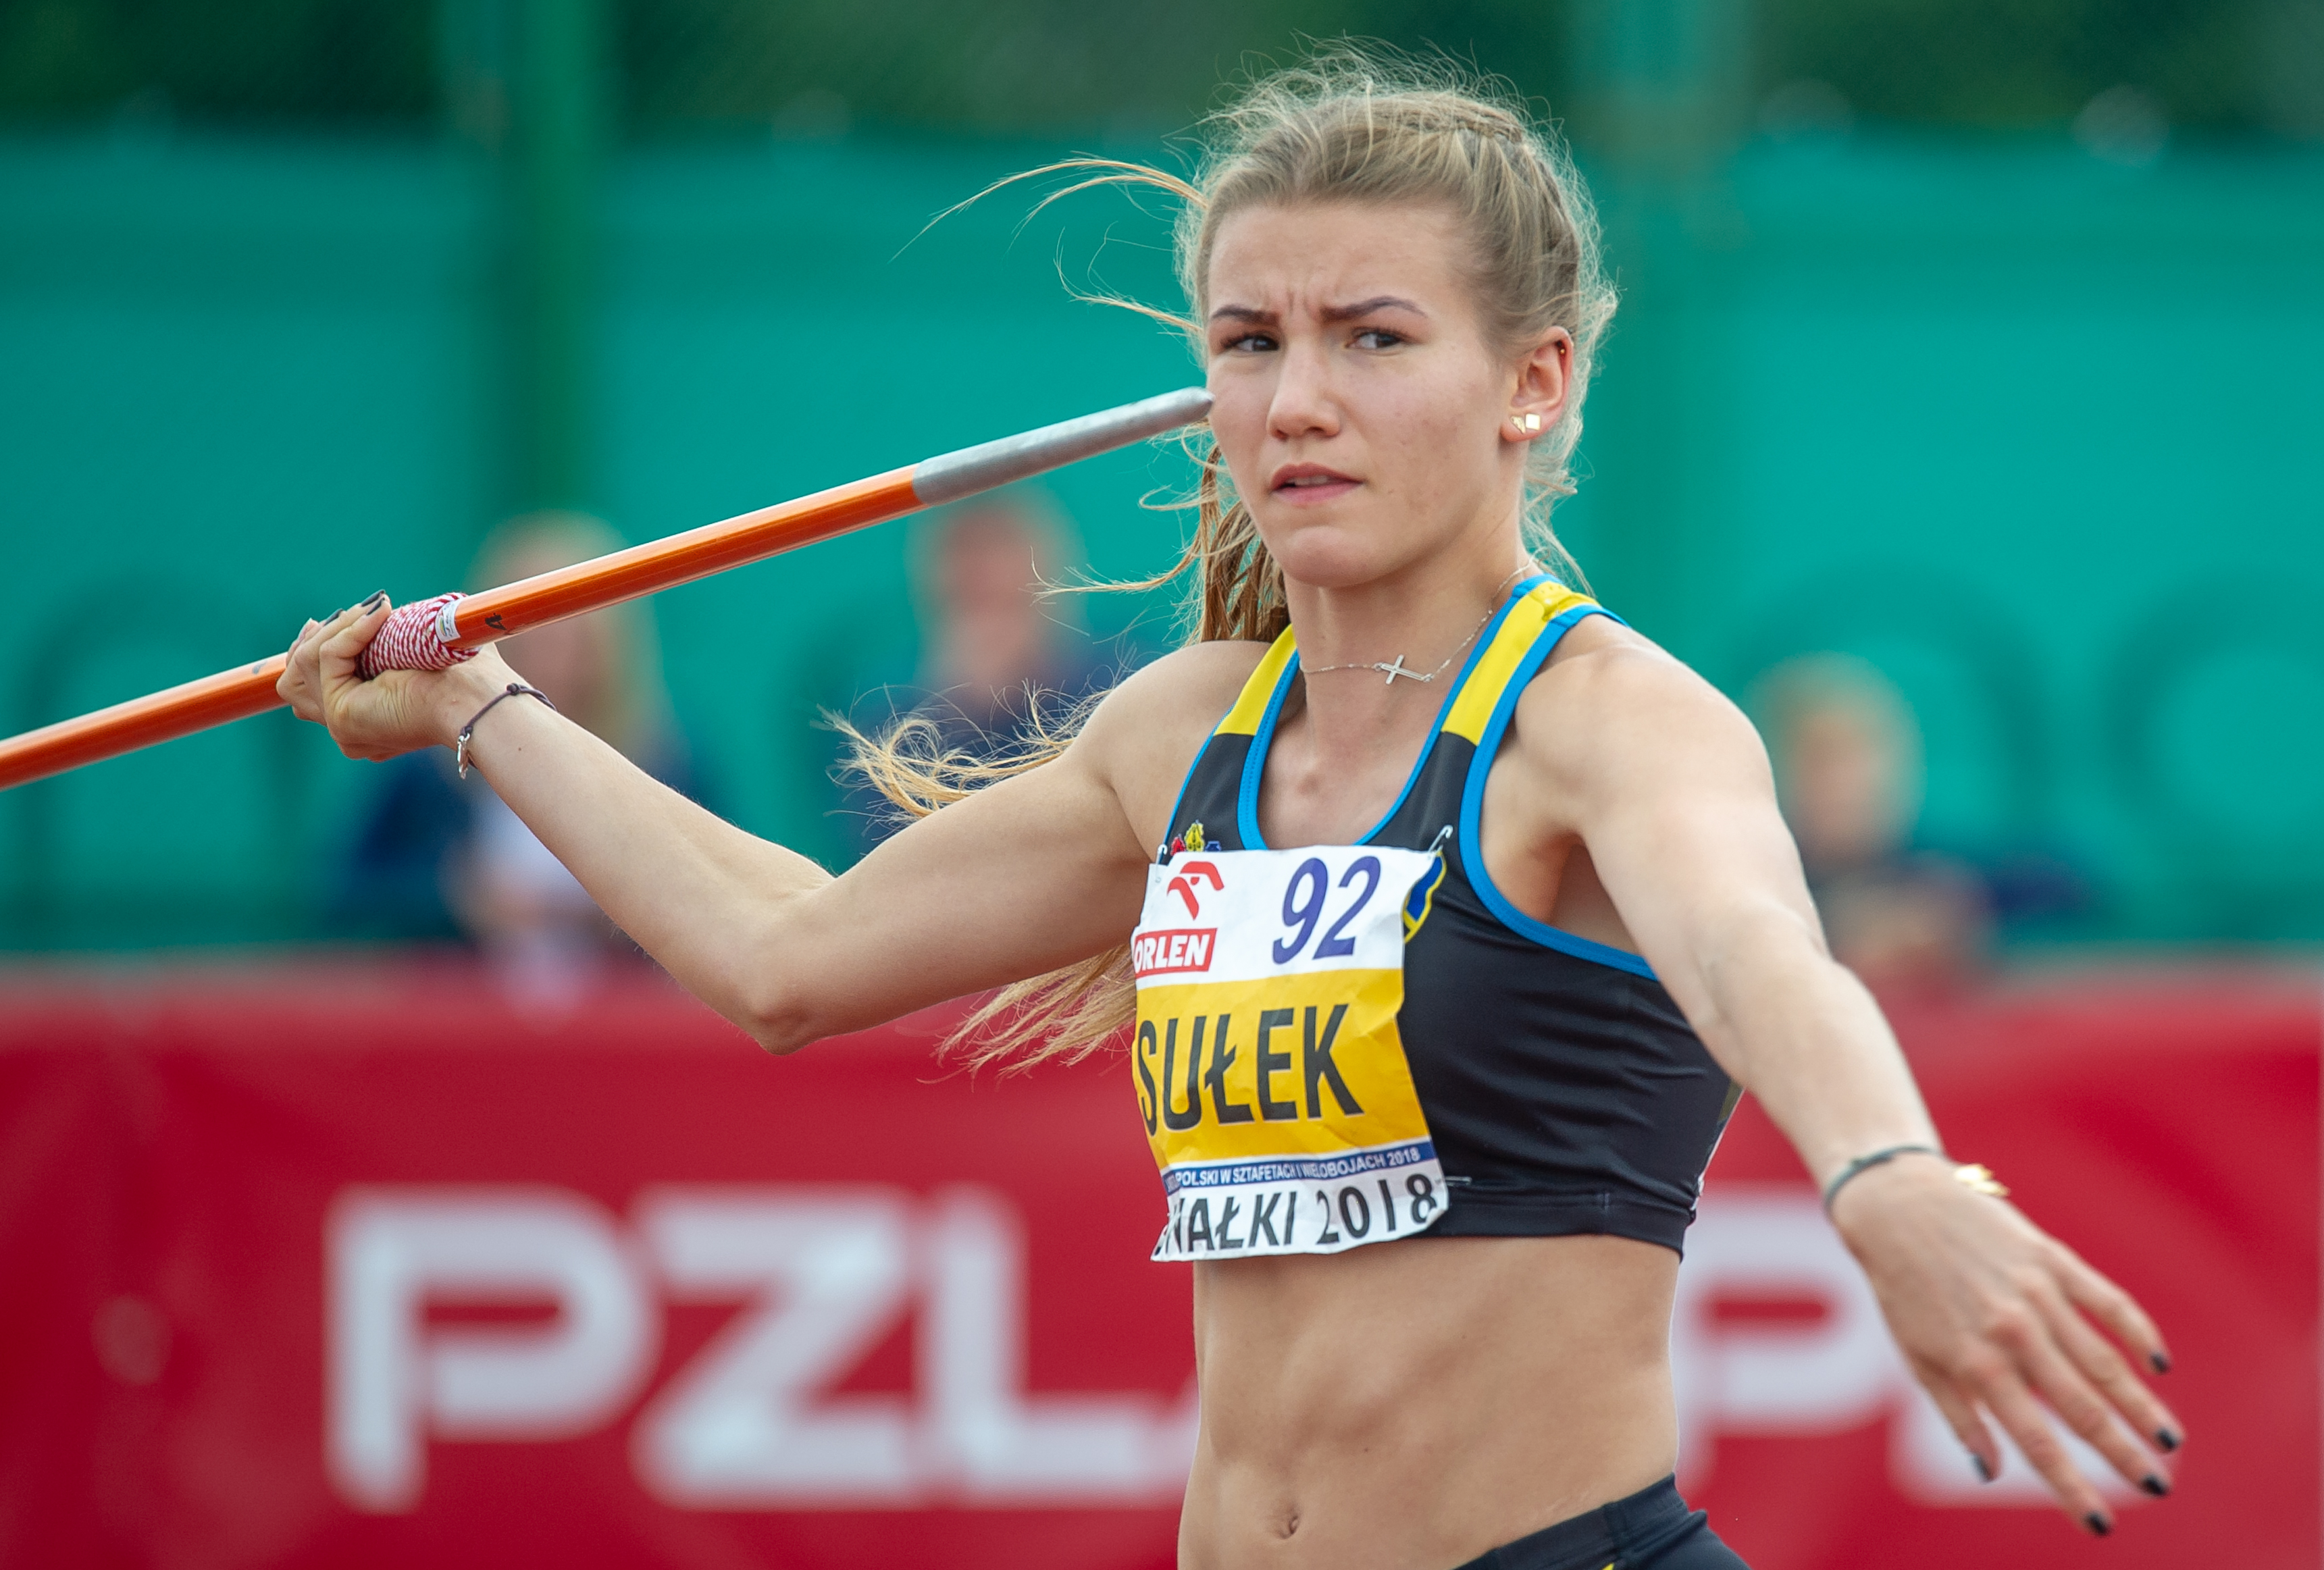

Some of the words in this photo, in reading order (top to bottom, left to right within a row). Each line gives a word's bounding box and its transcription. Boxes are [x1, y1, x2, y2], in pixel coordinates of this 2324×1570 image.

[1134, 934, 1211, 974] ORLEN
[1273, 856, 1381, 964] 92
[1137, 1003, 1365, 1137] SUŁEK
[1175, 1169, 1218, 1186] POLSKI
[1220, 1167, 1232, 1184] W
[1233, 1162, 1295, 1183] SZTAFETACH
[1387, 1147, 1420, 1166] 2018
[1316, 1174, 1437, 1245] 2018
[326, 1183, 1205, 1513] PZL
